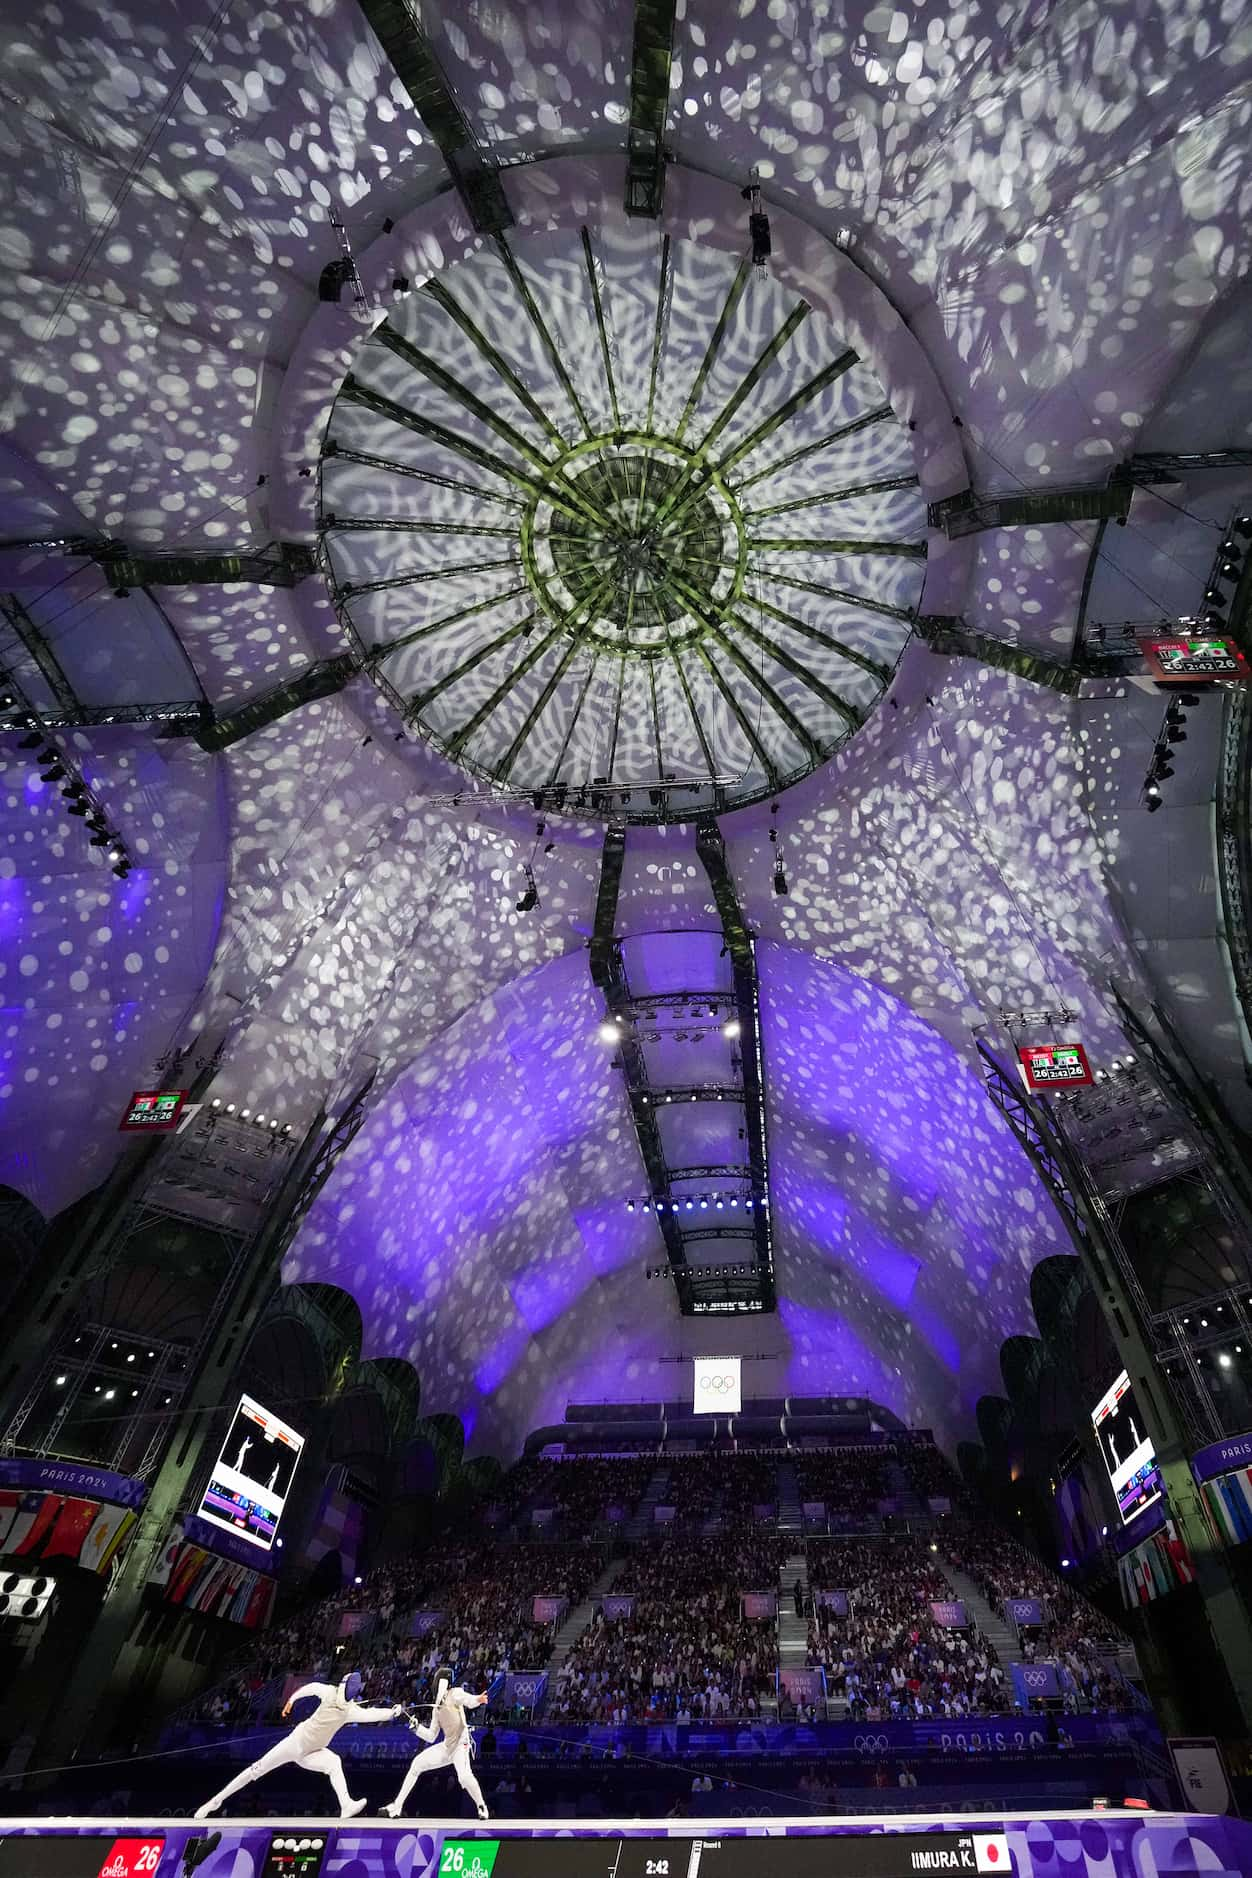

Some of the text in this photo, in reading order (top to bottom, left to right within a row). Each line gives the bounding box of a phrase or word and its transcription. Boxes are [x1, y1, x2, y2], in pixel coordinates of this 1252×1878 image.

[1187, 663, 1214, 671] 2:42
[1216, 660, 1236, 669] 26
[1035, 1070, 1048, 1078] 26
[1070, 1067, 1083, 1075] 26
[129, 1113, 142, 1121] 26
[160, 1112, 173, 1120] 26
[1221, 1444, 1251, 1460] PARIS
[40, 1468, 107, 1488] PARIS 2024
[958, 1839, 972, 1847] JPN
[134, 1846, 160, 1870] 26
[441, 1847, 465, 1872] 26
[911, 1850, 975, 1869] IIMURA K.
[102, 1866, 128, 1878] OMEGA
[461, 1868, 489, 1878] OMEGA
[646, 1860, 669, 1874] 2:42
